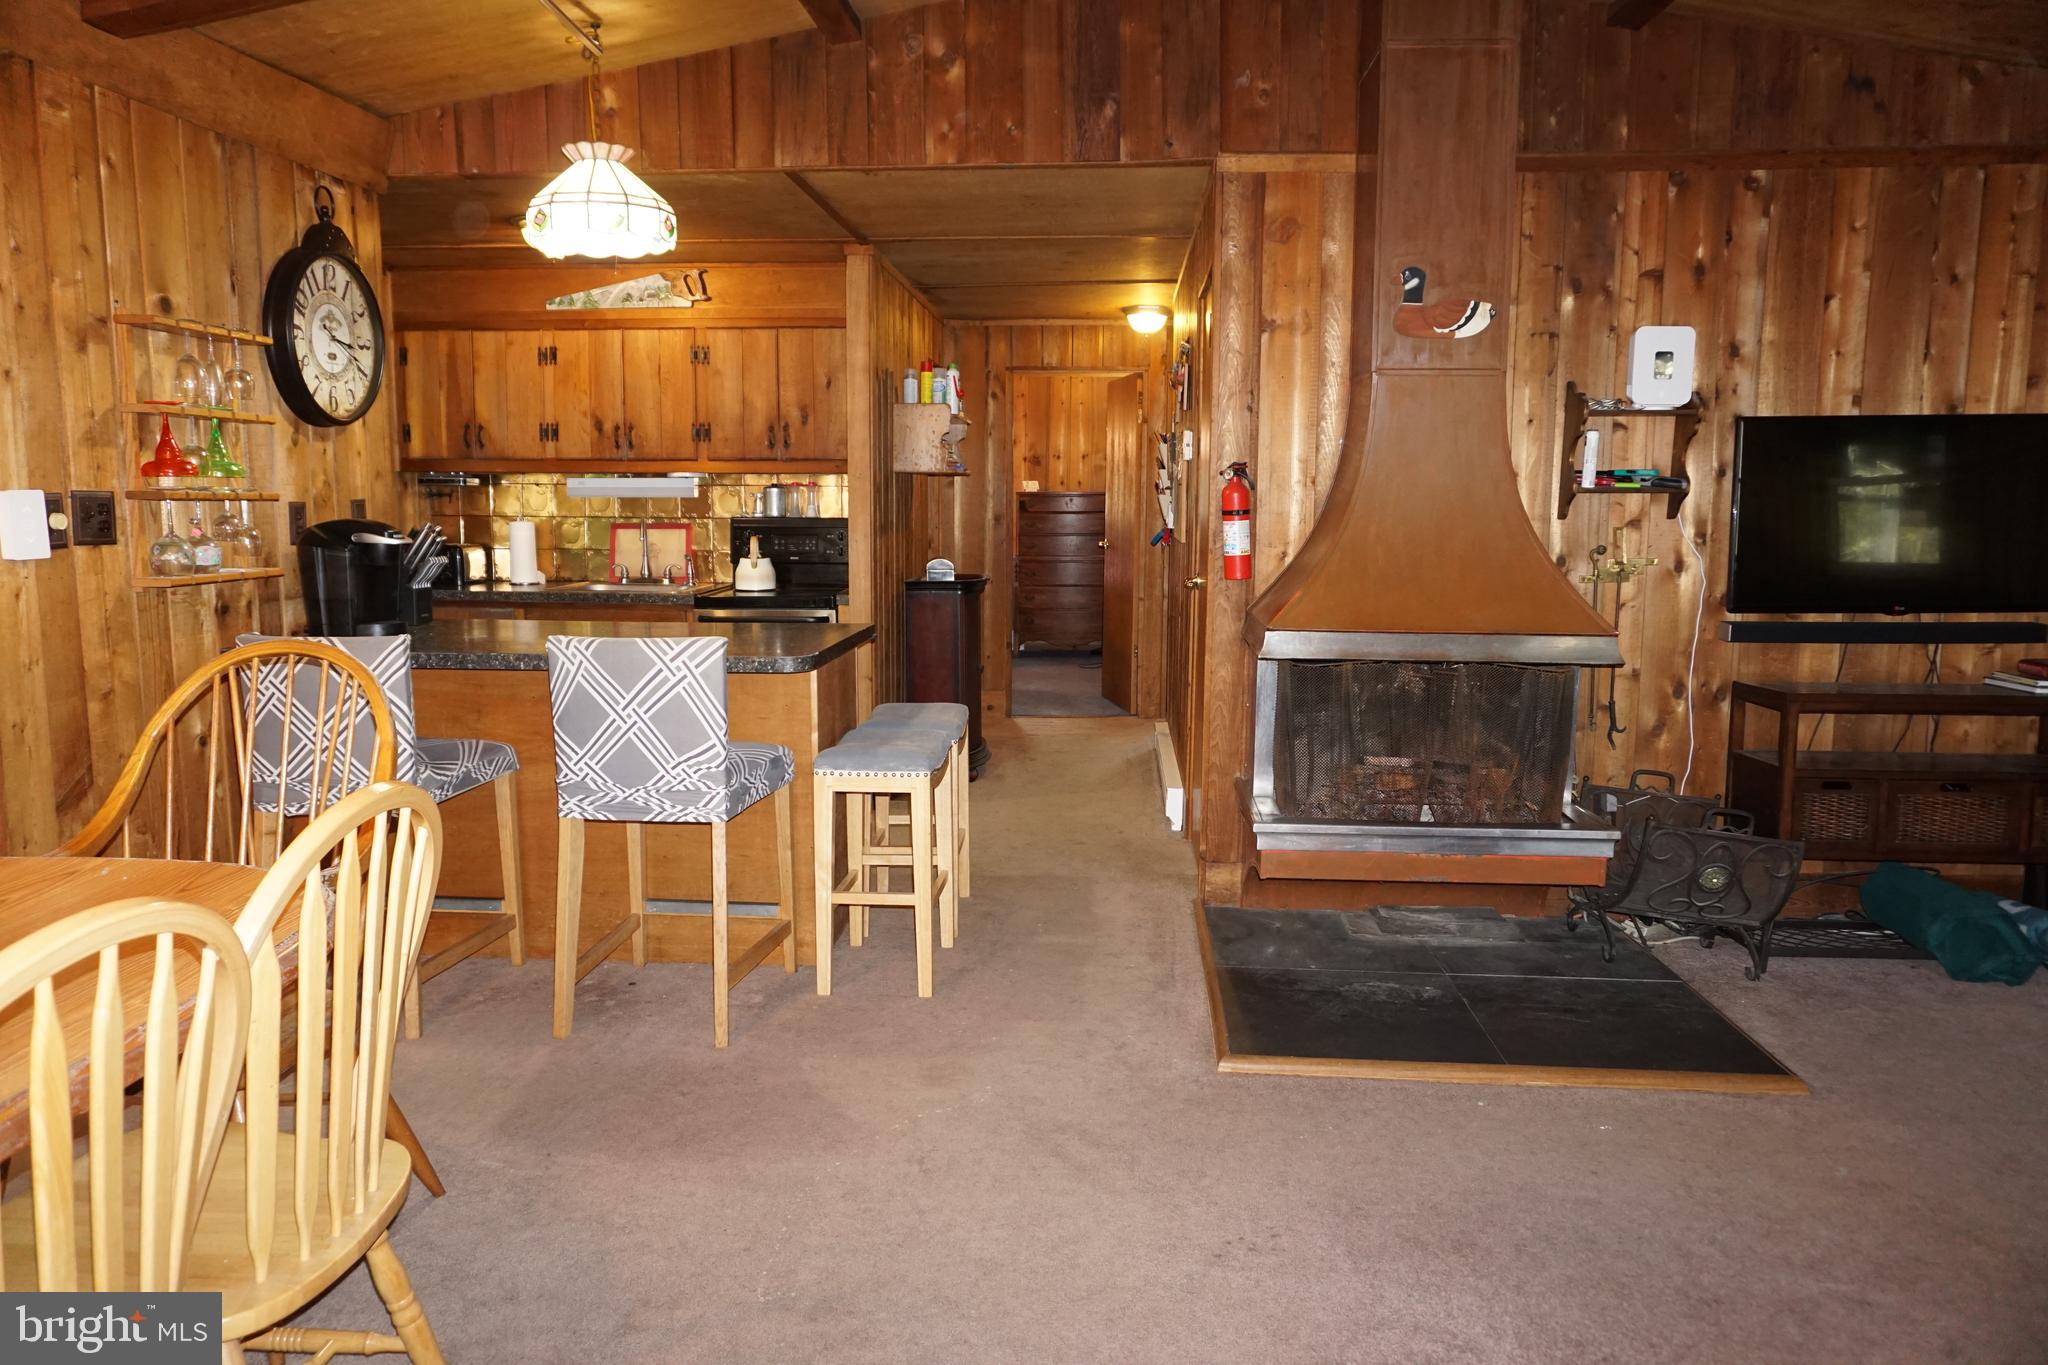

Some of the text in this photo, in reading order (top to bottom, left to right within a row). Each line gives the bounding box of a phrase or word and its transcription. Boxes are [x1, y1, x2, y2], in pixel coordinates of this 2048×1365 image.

[304, 266, 321, 297] 11
[322, 264, 337, 292] 12
[341, 280, 352, 301] 1
[352, 303, 367, 323] 2
[356, 336, 371, 351] 3
[313, 374, 322, 397] 7
[329, 385, 338, 412] 6
